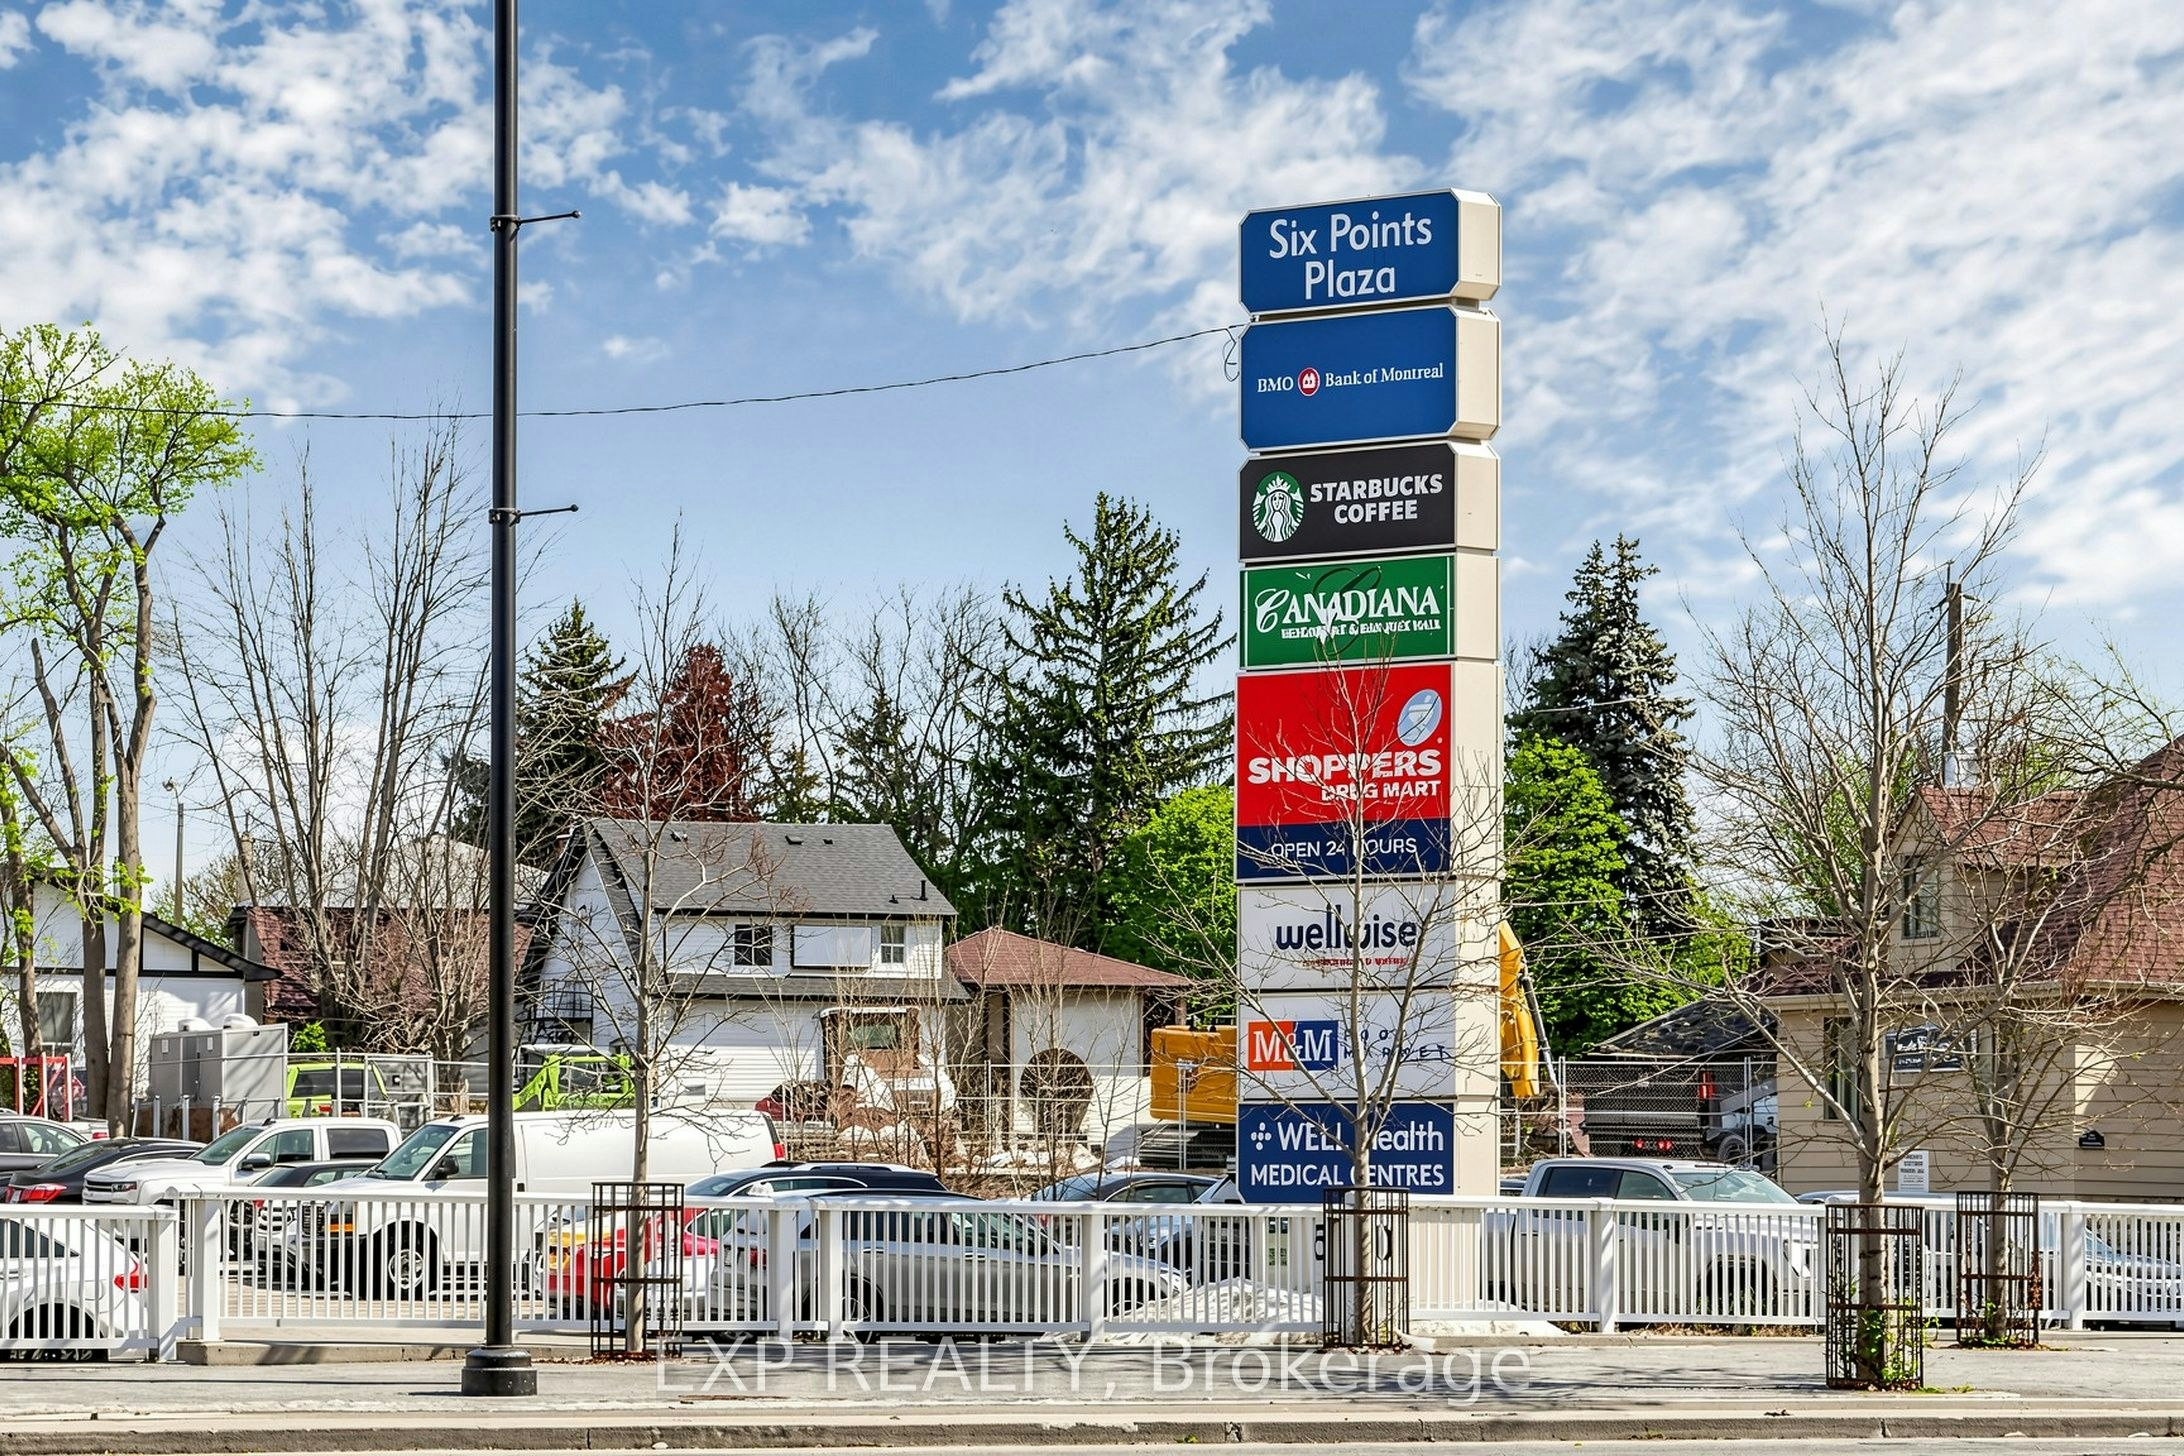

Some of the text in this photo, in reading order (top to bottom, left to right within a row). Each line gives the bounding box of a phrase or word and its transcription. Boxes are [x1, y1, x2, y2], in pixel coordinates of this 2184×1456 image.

[1269, 211, 1432, 259] Six Points
[1305, 259, 1396, 299] Plaza
[1257, 362, 1443, 393] BMO Bank of Montreal
[1310, 474, 1443, 503] STARBUCKS
[1334, 500, 1418, 524] COFFEE
[1255, 586, 1440, 633] CANADIANA
[1248, 749, 1442, 785] SHOPPERS
[1383, 779, 1441, 798] MART
[1271, 837, 1417, 858] OPEN 24 OURS
[1253, 1029, 1333, 1063] M&M
[1277, 1122, 1349, 1151] WELL
[1251, 1164, 1344, 1186] MEDICAL
